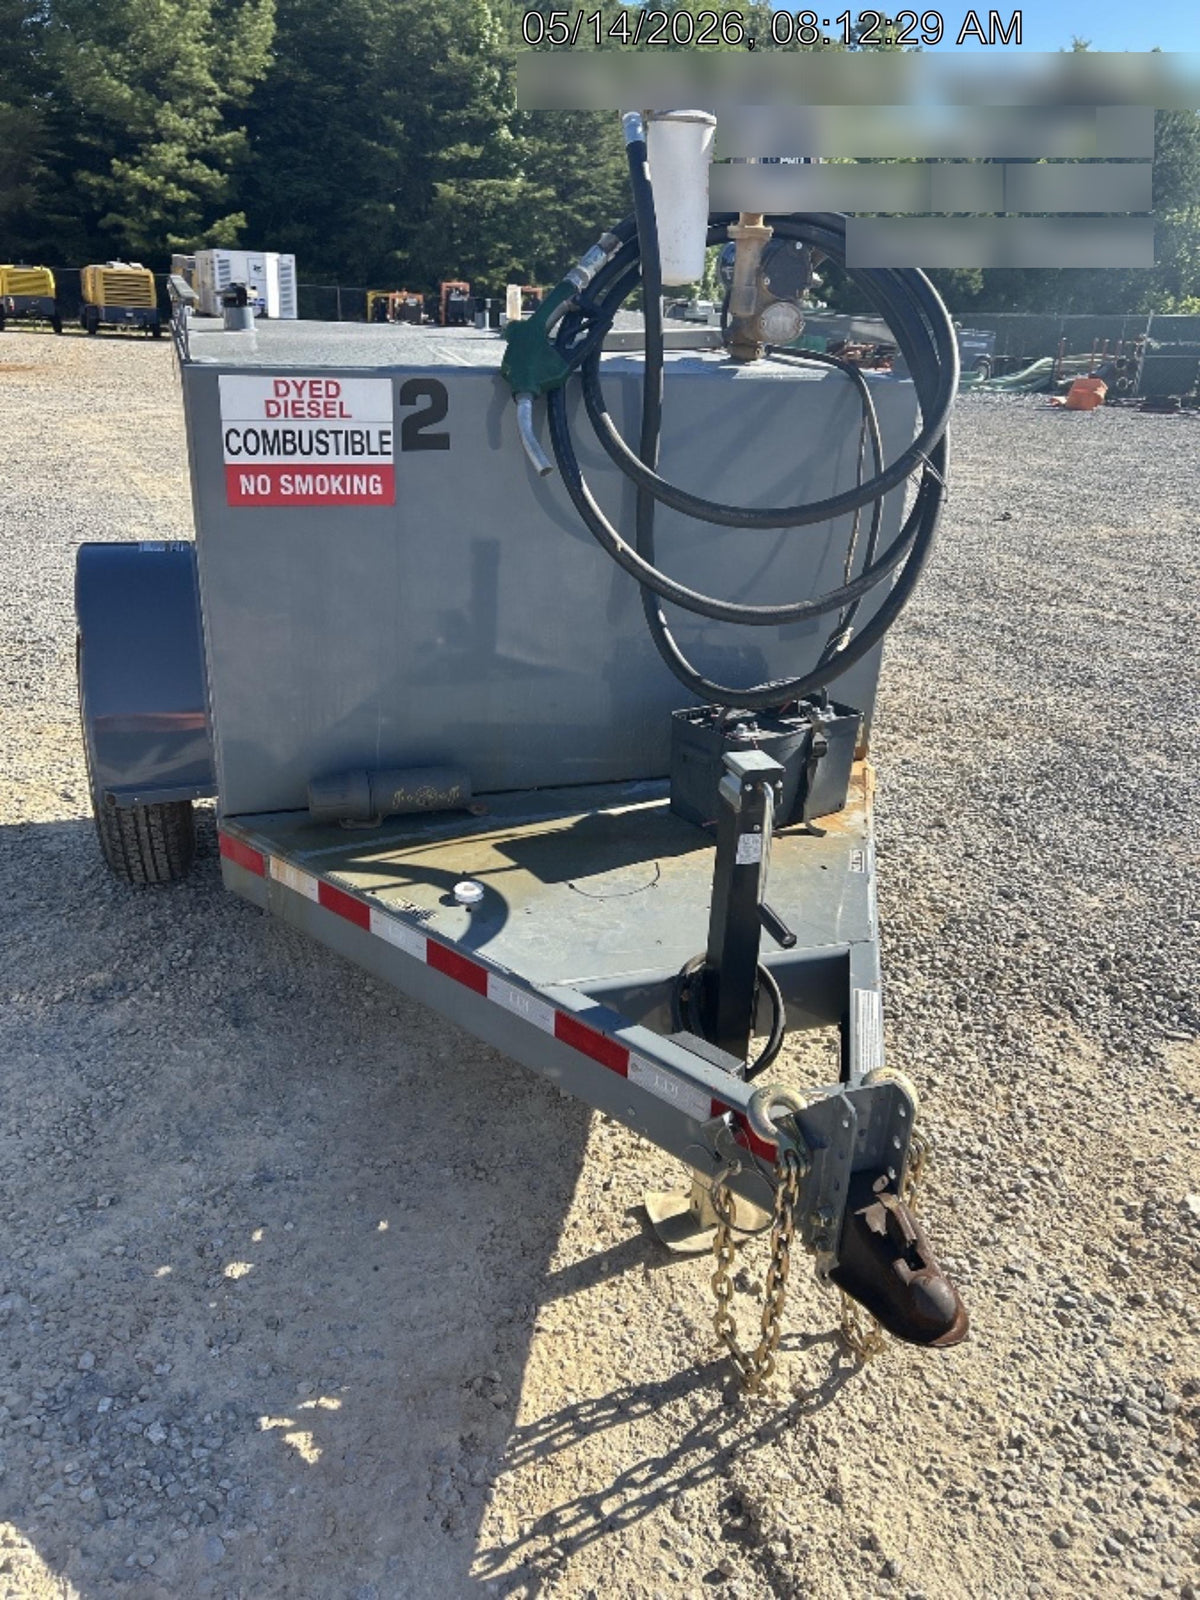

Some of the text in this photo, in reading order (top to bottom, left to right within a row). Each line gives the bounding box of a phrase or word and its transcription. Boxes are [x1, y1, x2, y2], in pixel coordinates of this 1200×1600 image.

[273, 379, 341, 399] DYED
[265, 400, 352, 419] DIESEL
[399, 378, 451, 451] 2
[225, 428, 392, 456] COMBUSTIBLE
[240, 474, 383, 496] NO SMOKING
